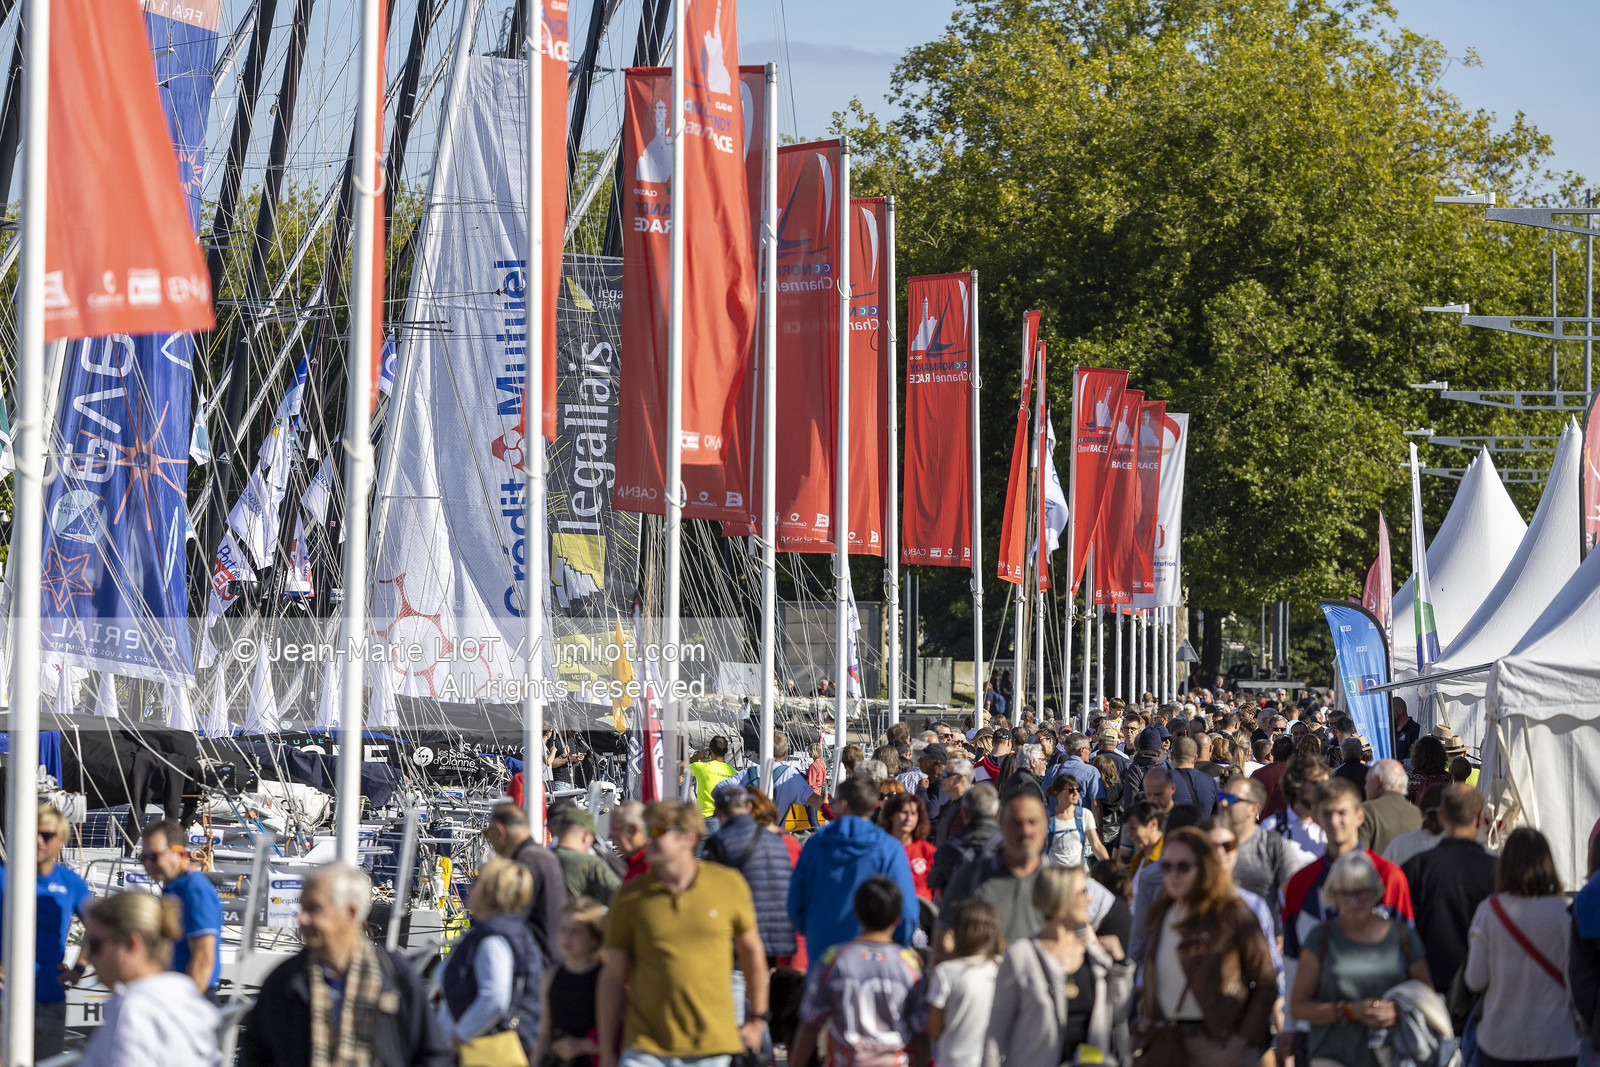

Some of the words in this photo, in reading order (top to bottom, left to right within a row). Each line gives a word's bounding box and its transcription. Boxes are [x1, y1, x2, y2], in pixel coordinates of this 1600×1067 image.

[558, 340, 615, 531] legallais
[1090, 444, 1109, 453] RACE
[1112, 461, 1133, 470] RACE
[1137, 462, 1159, 470] RACE
[437, 747, 449, 756] les
